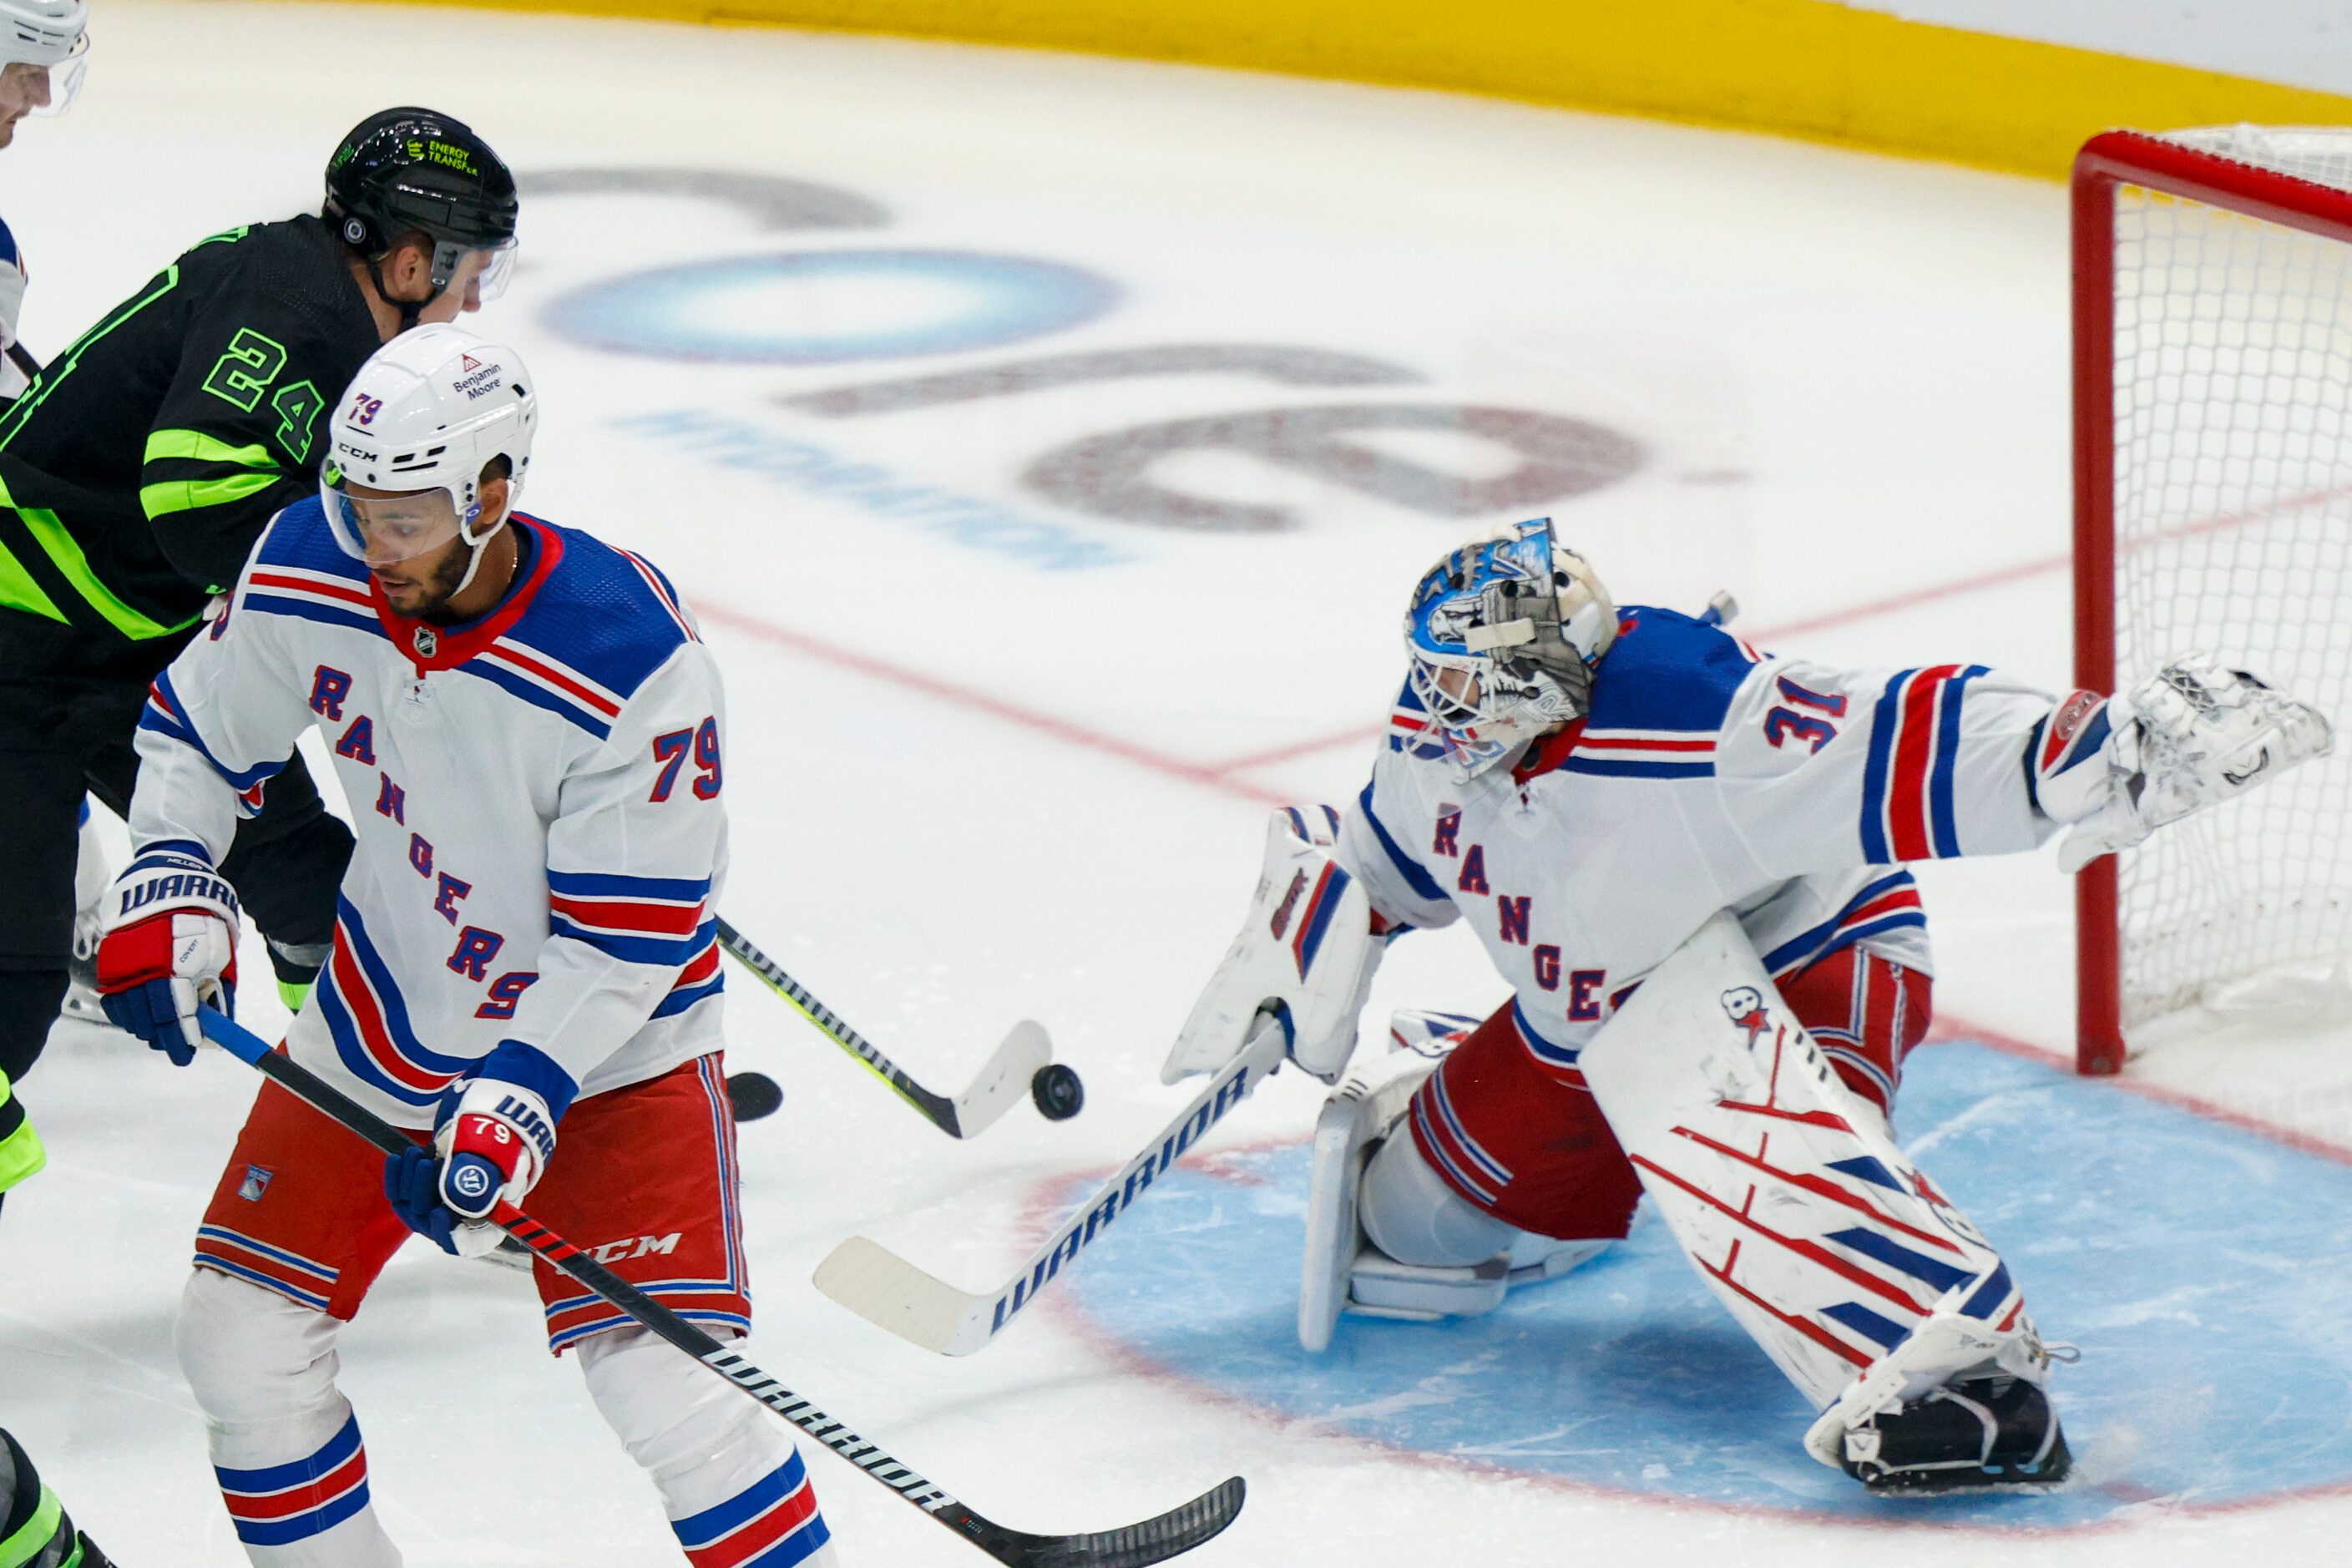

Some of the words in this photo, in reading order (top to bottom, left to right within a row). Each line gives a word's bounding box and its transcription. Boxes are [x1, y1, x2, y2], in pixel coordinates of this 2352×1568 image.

[428, 139, 469, 161] ENERGY
[428, 150, 478, 177] TRANSFER
[201, 326, 326, 464] 24
[453, 364, 501, 392] Benjamin
[467, 377, 501, 401] Moore
[349, 393, 382, 424] 79
[339, 443, 378, 463] CCM
[1763, 675, 1849, 756] 31
[649, 716, 723, 803] 79
[309, 665, 539, 1019] RANGERS
[168, 857, 203, 870] MILLER
[731, 935, 898, 1081] WARRIOR
[473, 1117, 511, 1145] 79
[990, 1065, 1249, 1338] WARRIOR
[558, 1232, 682, 1272] CM
[701, 1348, 959, 1515] WARRIOR
